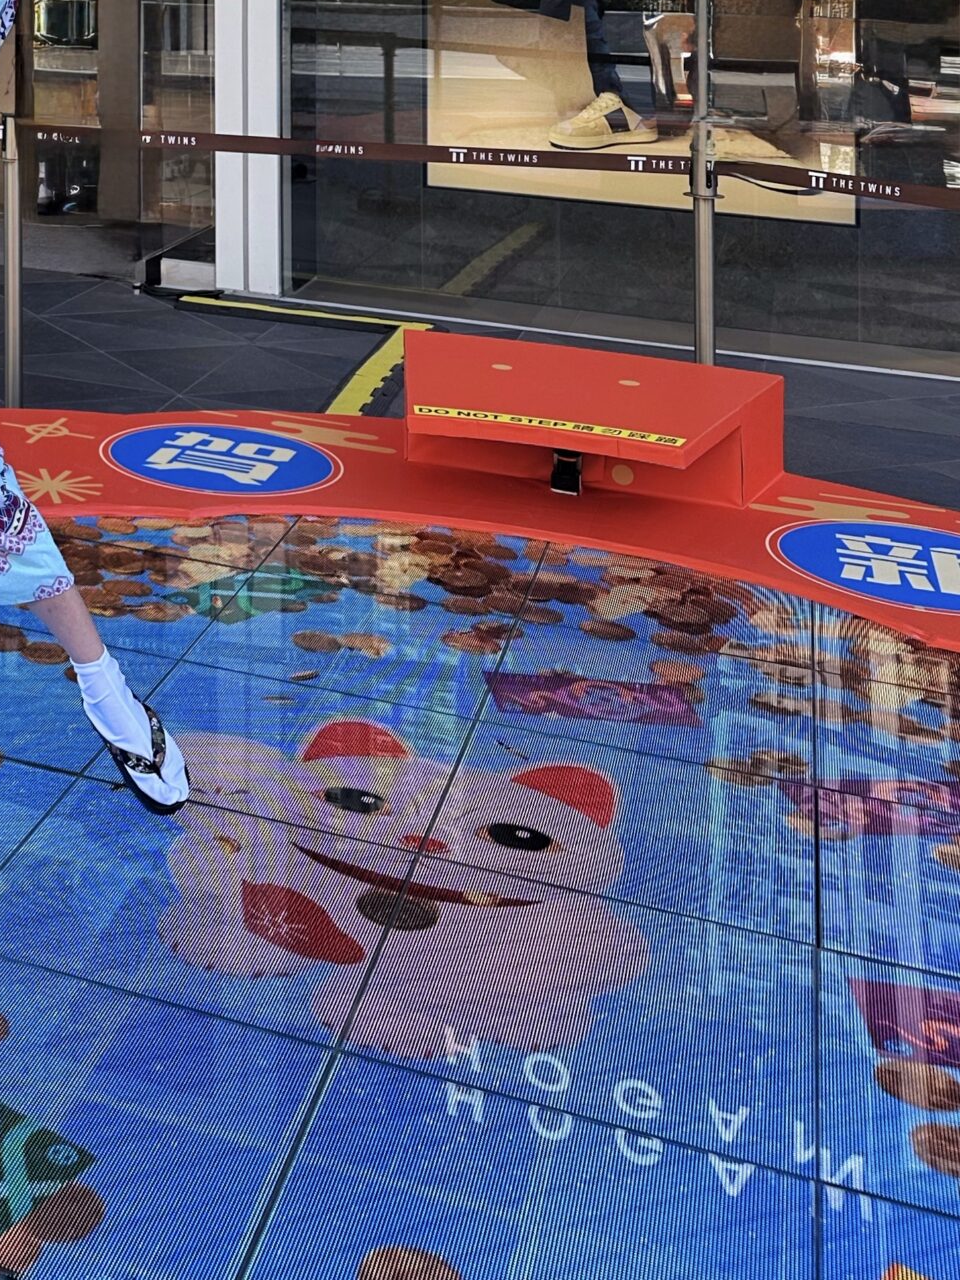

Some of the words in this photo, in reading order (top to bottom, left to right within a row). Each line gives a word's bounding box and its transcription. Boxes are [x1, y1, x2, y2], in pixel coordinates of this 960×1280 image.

[160, 135, 196, 146] TWINS
[472, 151, 493, 161] THE
[499, 153, 538, 163] TWINS
[652, 159, 673, 170] THE
[831, 177, 854, 190] THE
[860, 181, 901, 197] TWINS
[418, 406, 450, 415] DO
[457, 409, 501, 420] NOT
[509, 416, 567, 428] STEP
